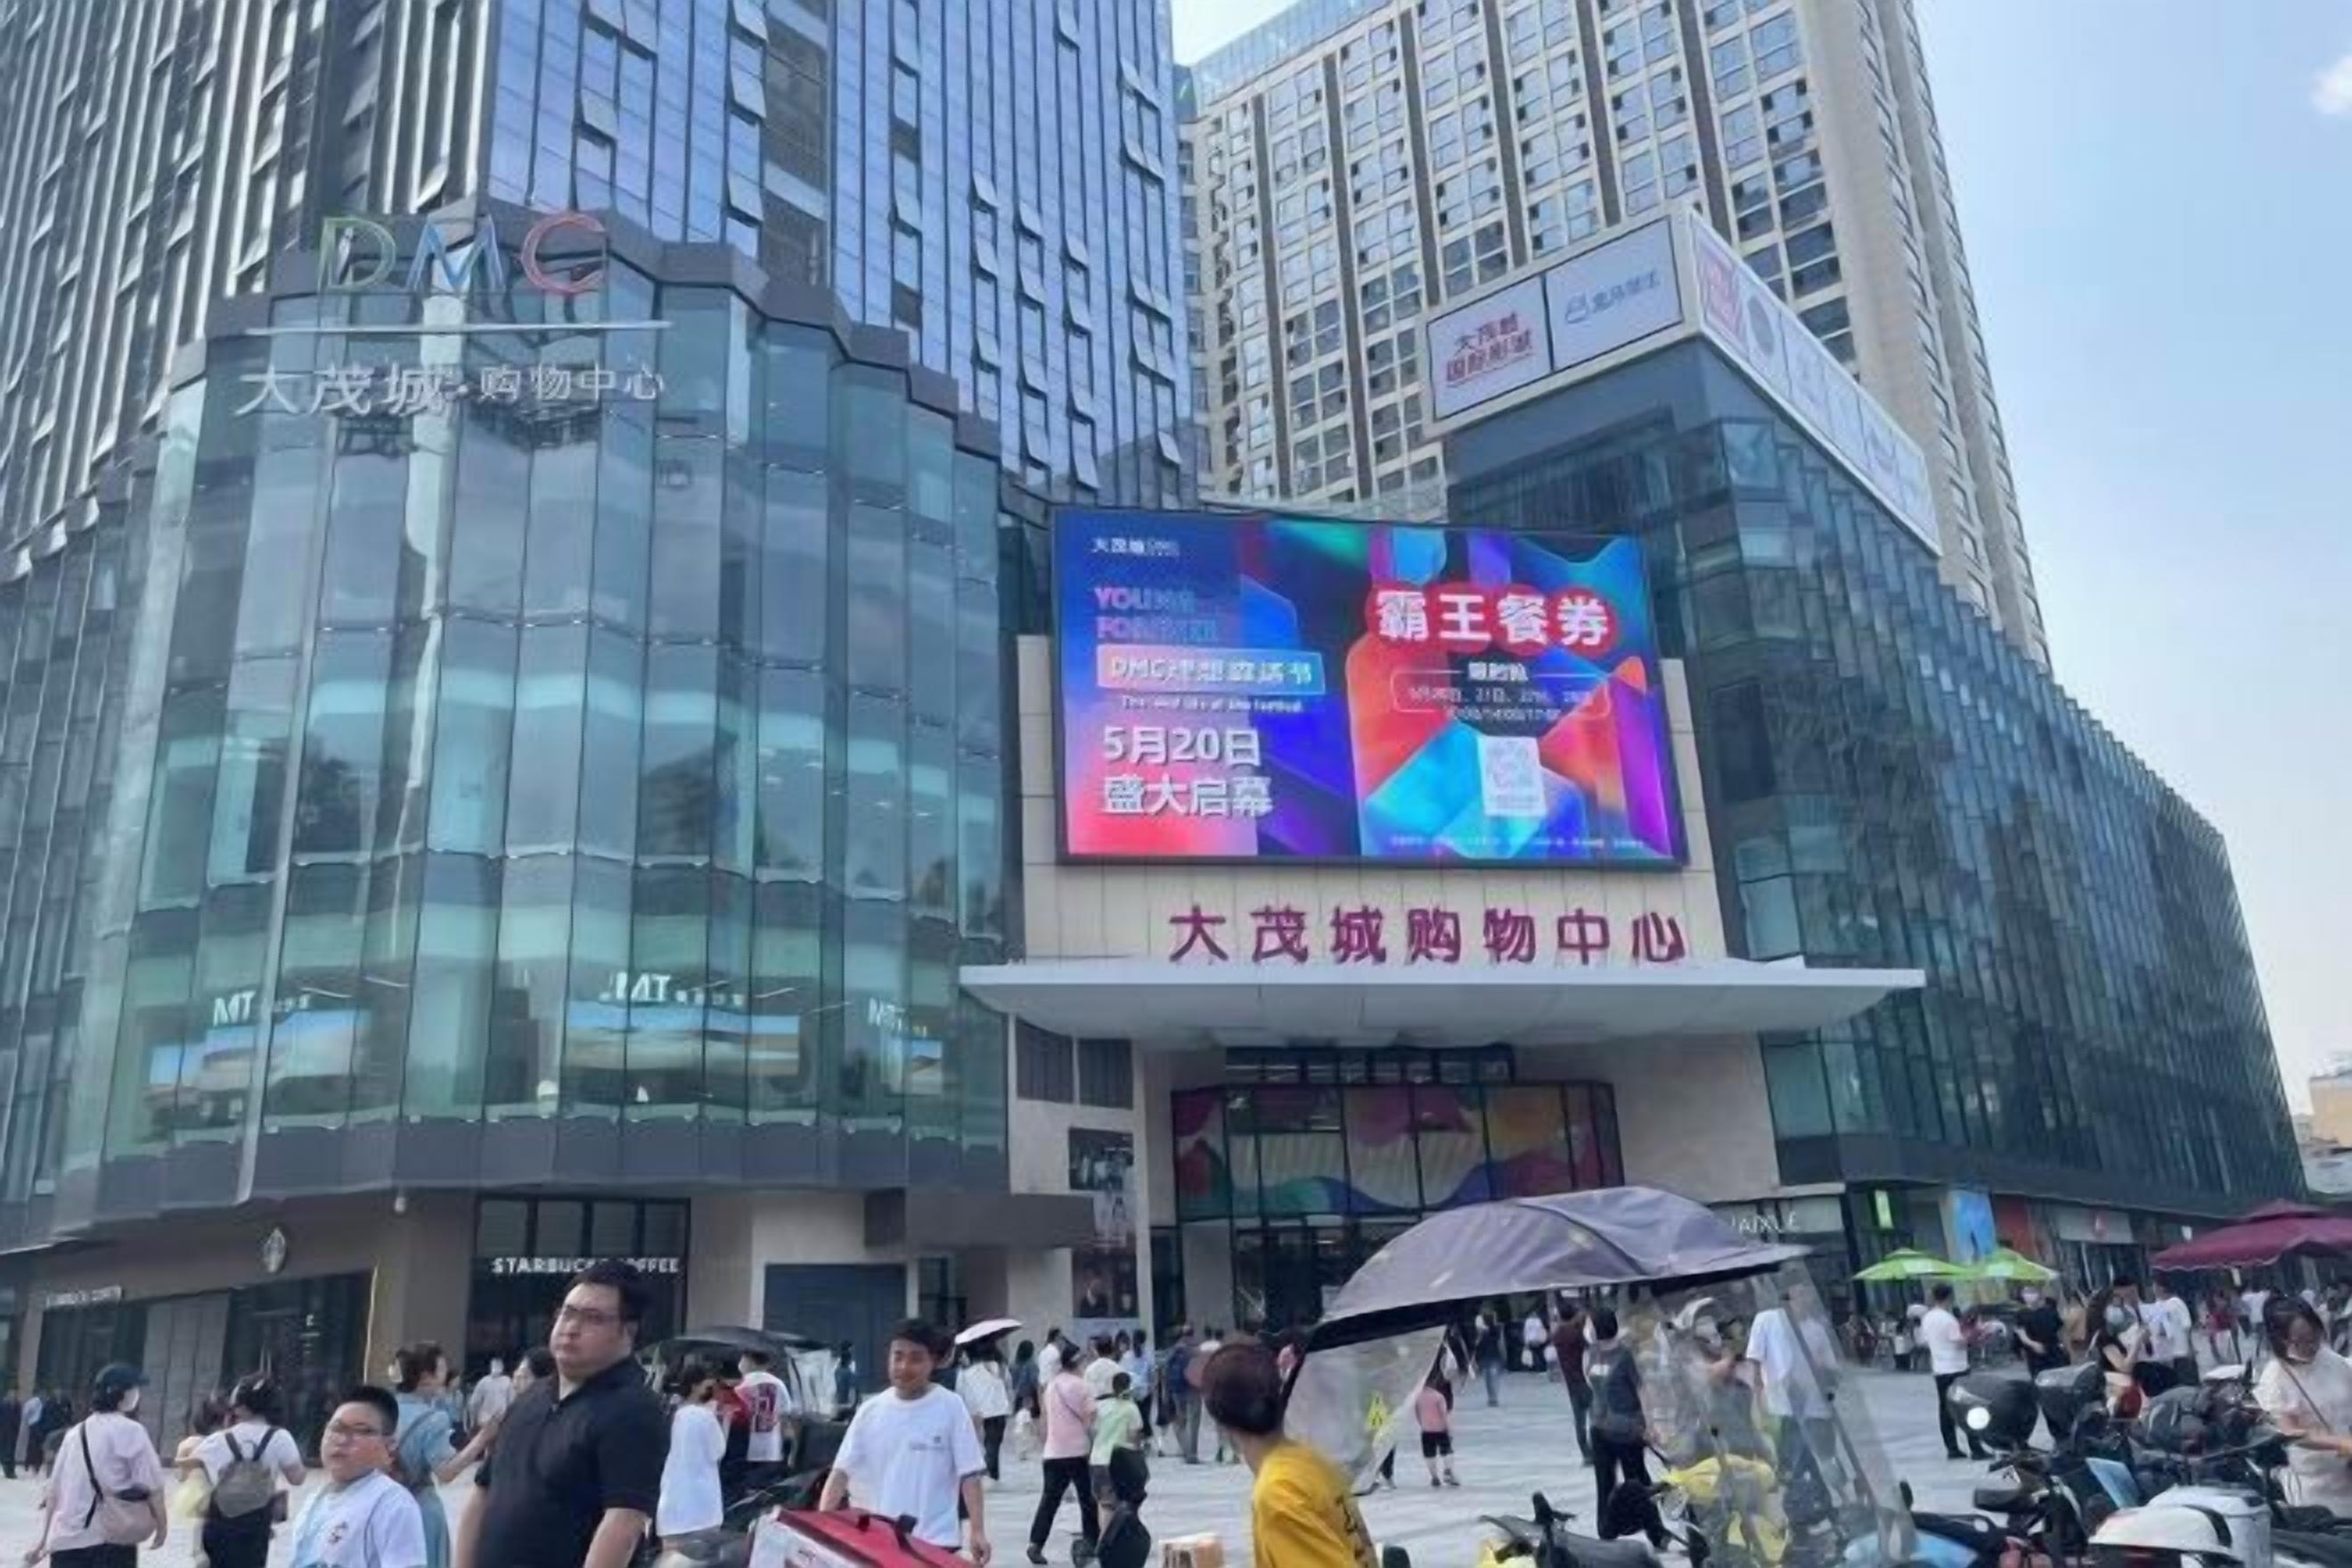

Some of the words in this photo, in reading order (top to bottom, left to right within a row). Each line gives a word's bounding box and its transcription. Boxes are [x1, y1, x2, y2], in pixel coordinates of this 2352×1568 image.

[1376, 591, 1608, 646] 霸王餐券
[1102, 726, 1262, 766] 5月20日
[1103, 773, 1274, 817] 盛大启幕
[1169, 904, 1686, 966] 大茂城购物中心
[491, 1257, 609, 1274] STARBUC
